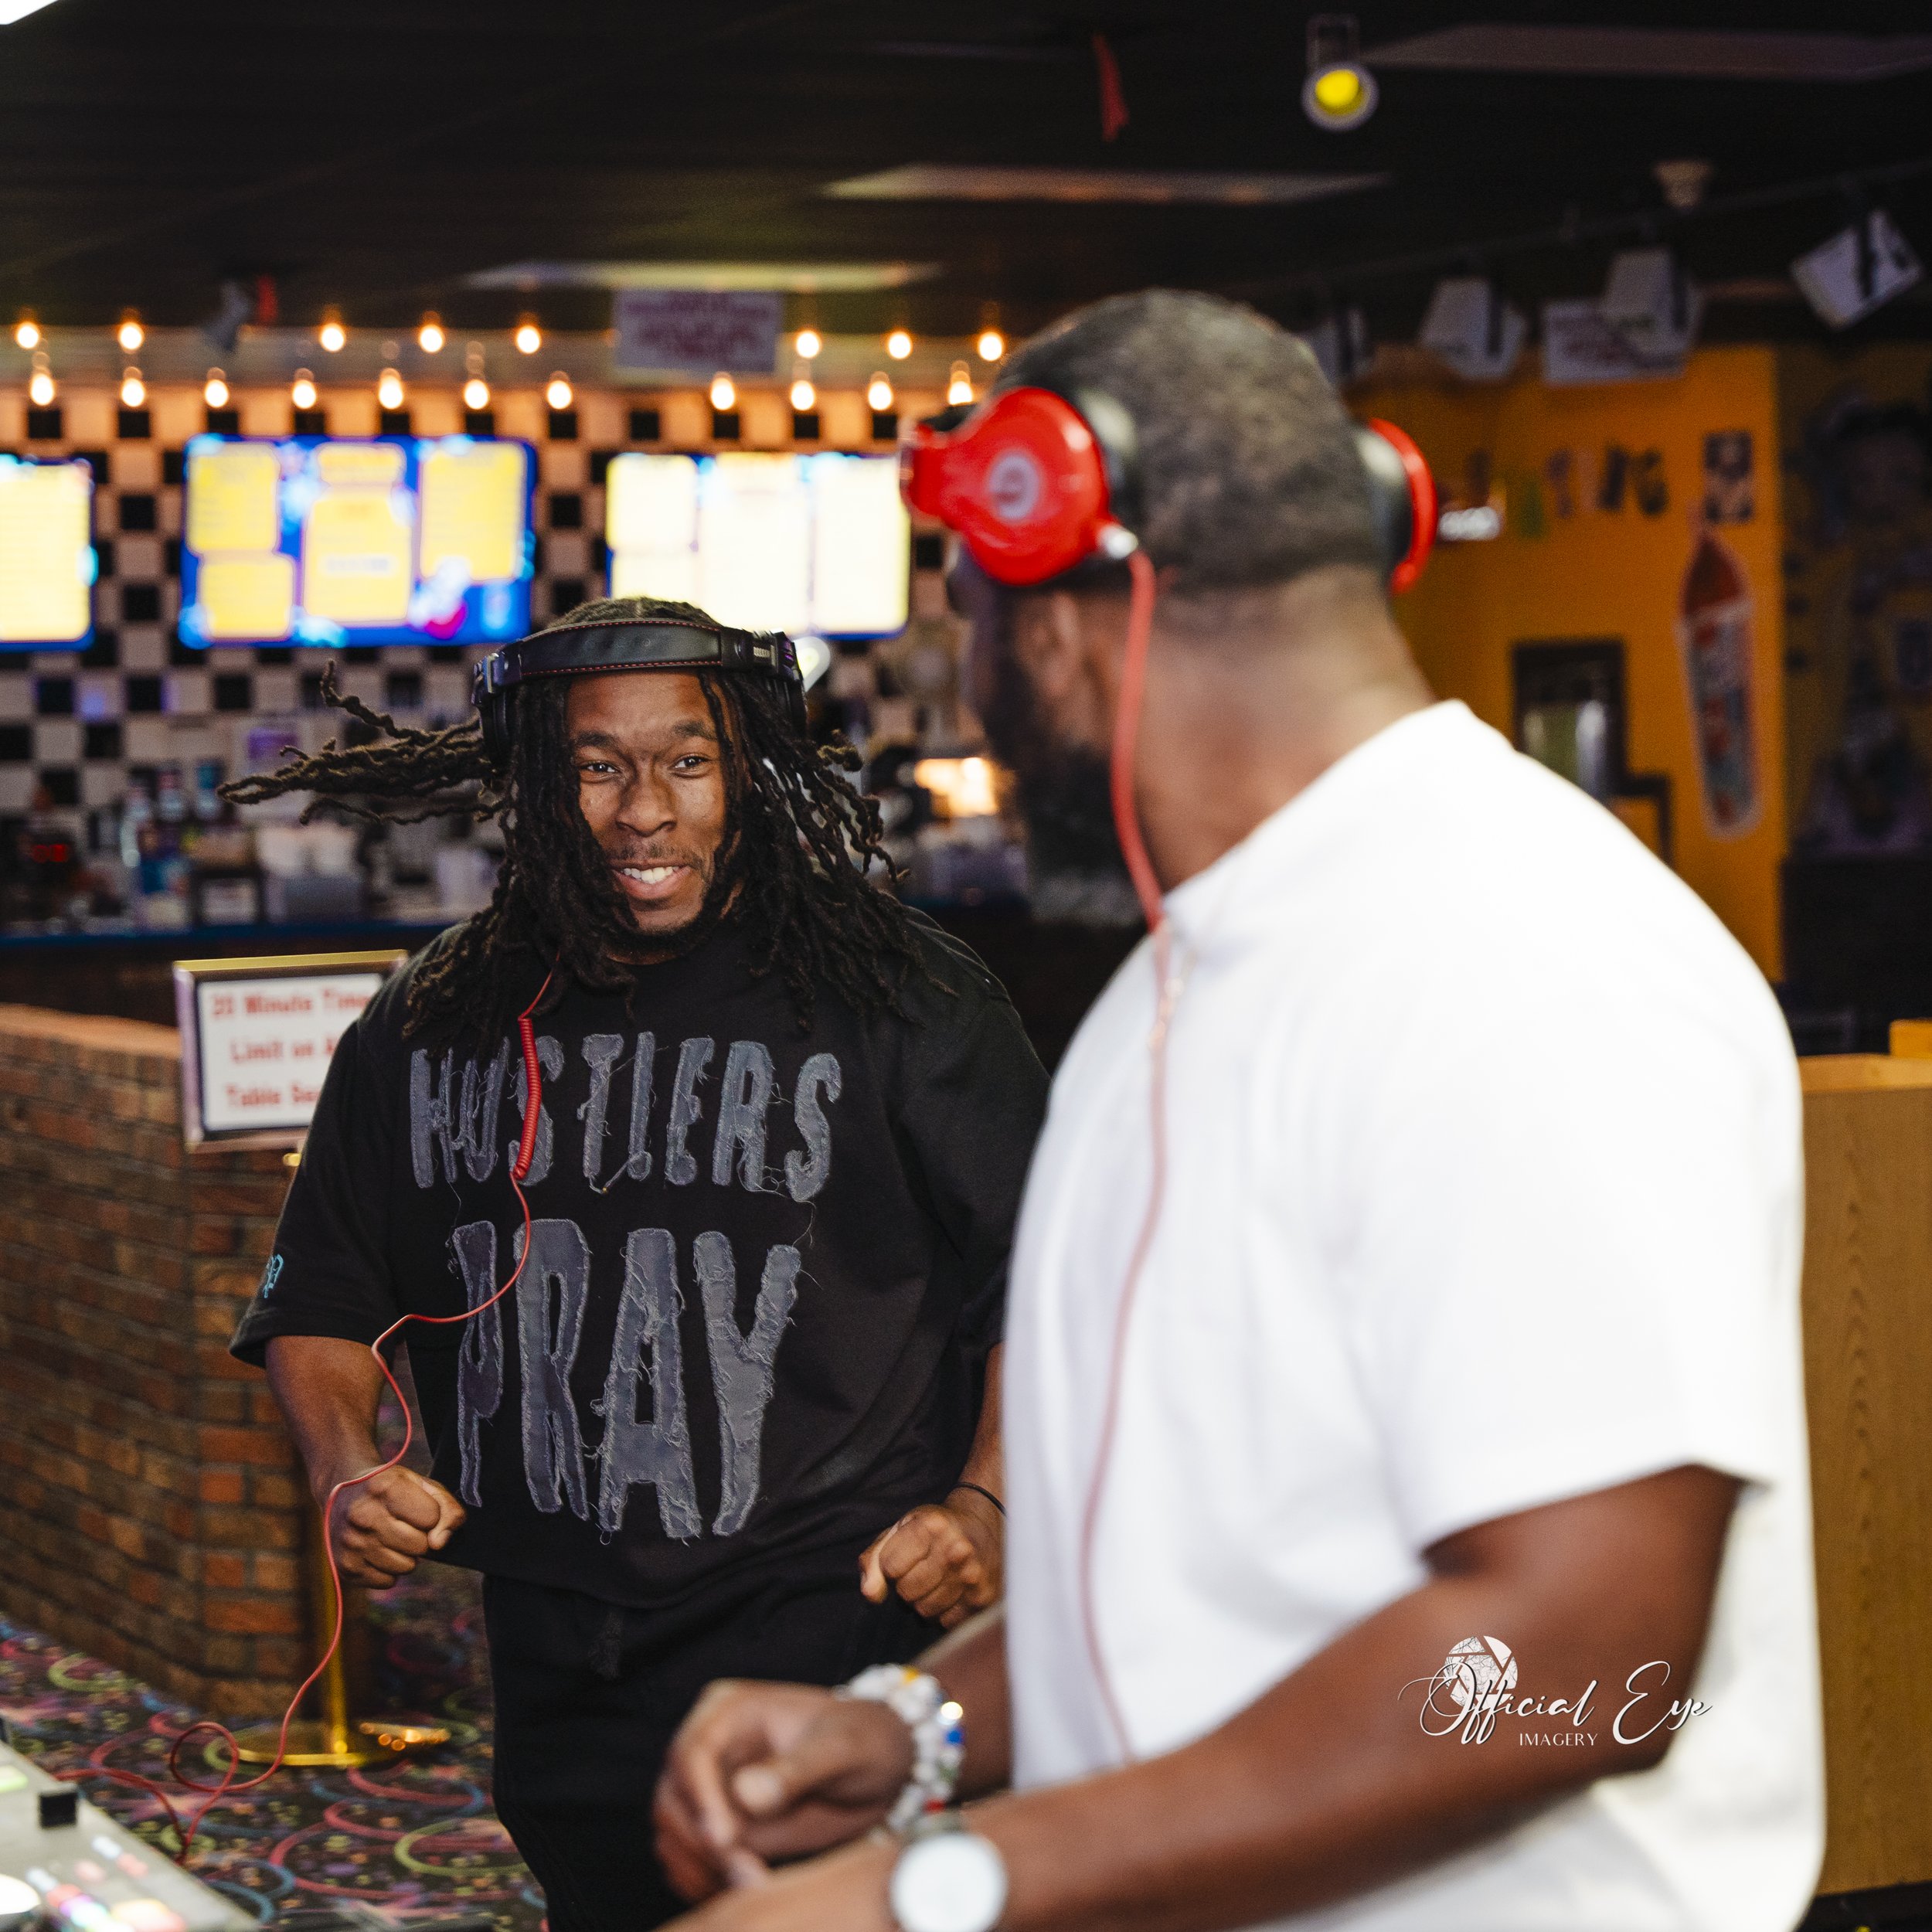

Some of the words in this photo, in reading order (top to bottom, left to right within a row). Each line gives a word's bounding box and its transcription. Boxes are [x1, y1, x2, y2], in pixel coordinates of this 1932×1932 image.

[243, 994, 313, 1014] Minute
[230, 1039, 284, 1062] Limit
[292, 1043, 314, 1057] on
[226, 1082, 281, 1105] Table
[452, 1219, 801, 1538] PRAY
